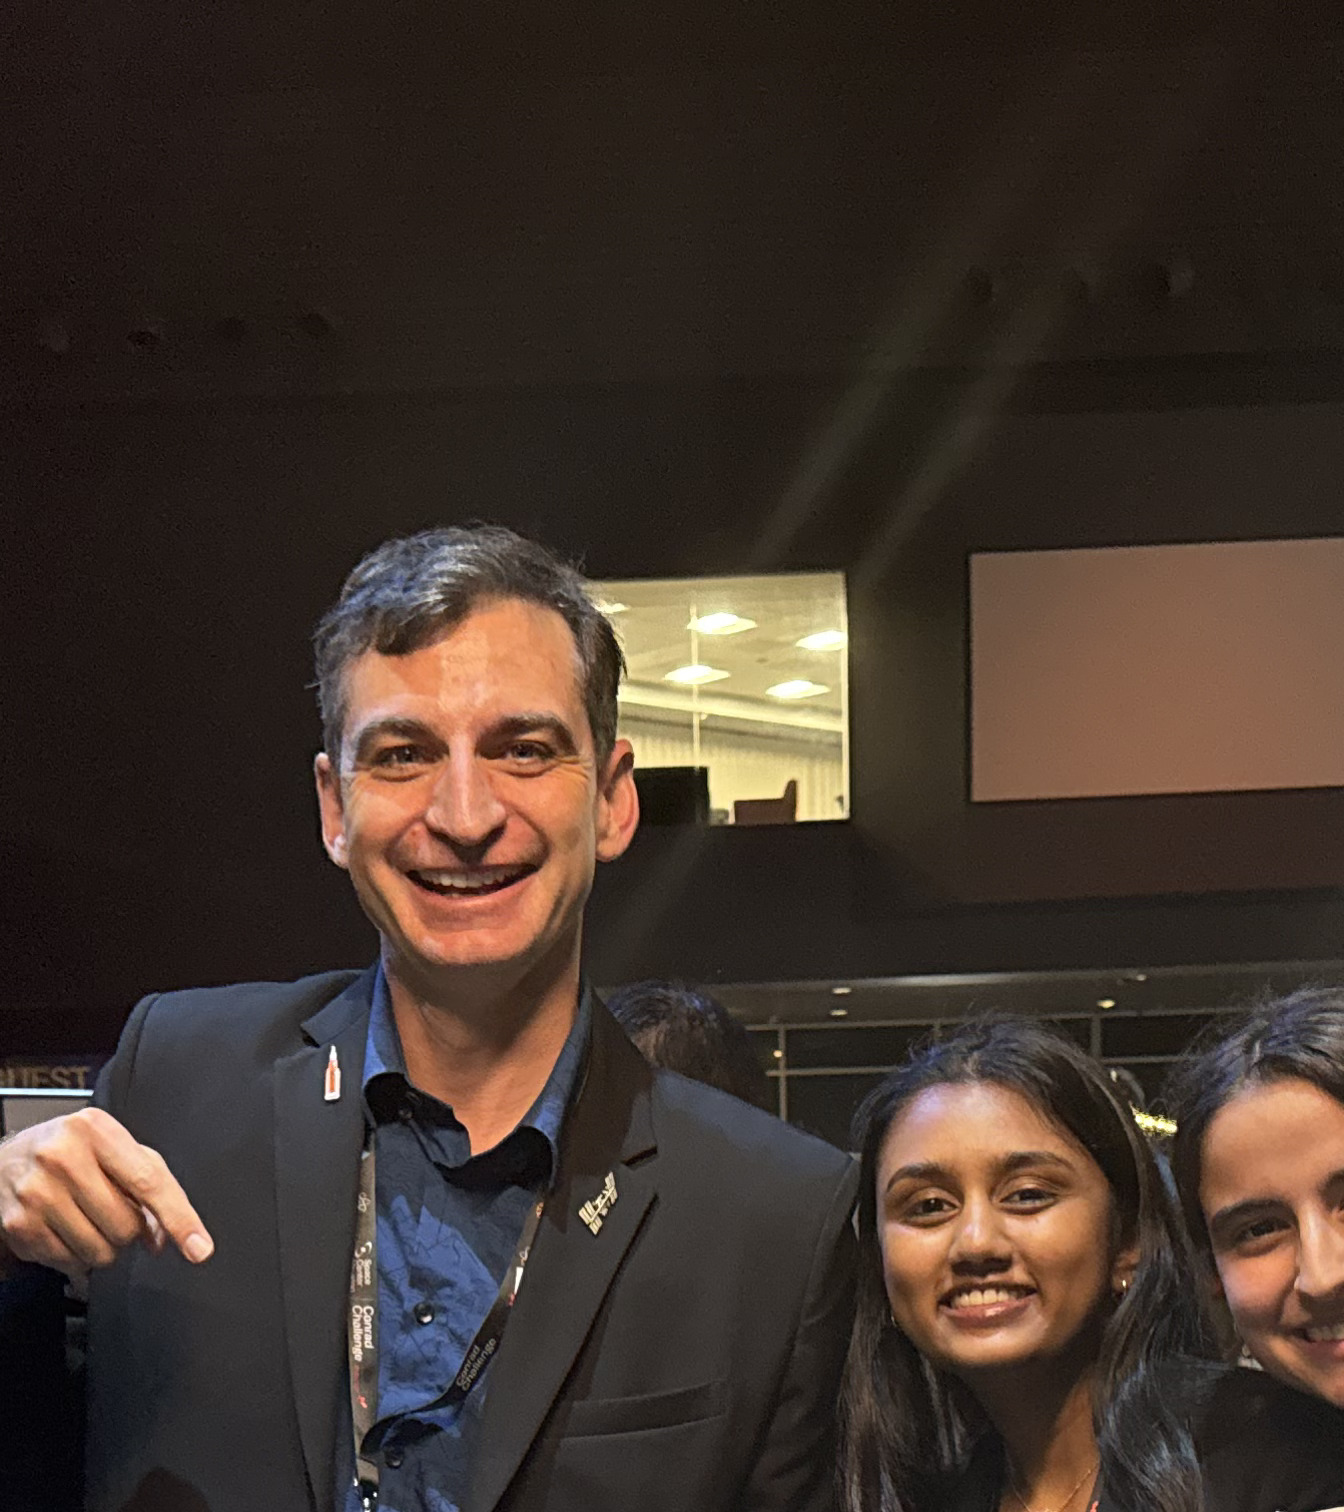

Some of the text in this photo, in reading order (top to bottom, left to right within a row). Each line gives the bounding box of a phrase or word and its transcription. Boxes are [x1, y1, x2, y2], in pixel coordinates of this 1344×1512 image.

[352, 1305, 364, 1362] Challenge
[363, 1305, 375, 1349] Conrad
[456, 1345, 480, 1387] Conrad
[462, 1338, 496, 1391] Challenge
